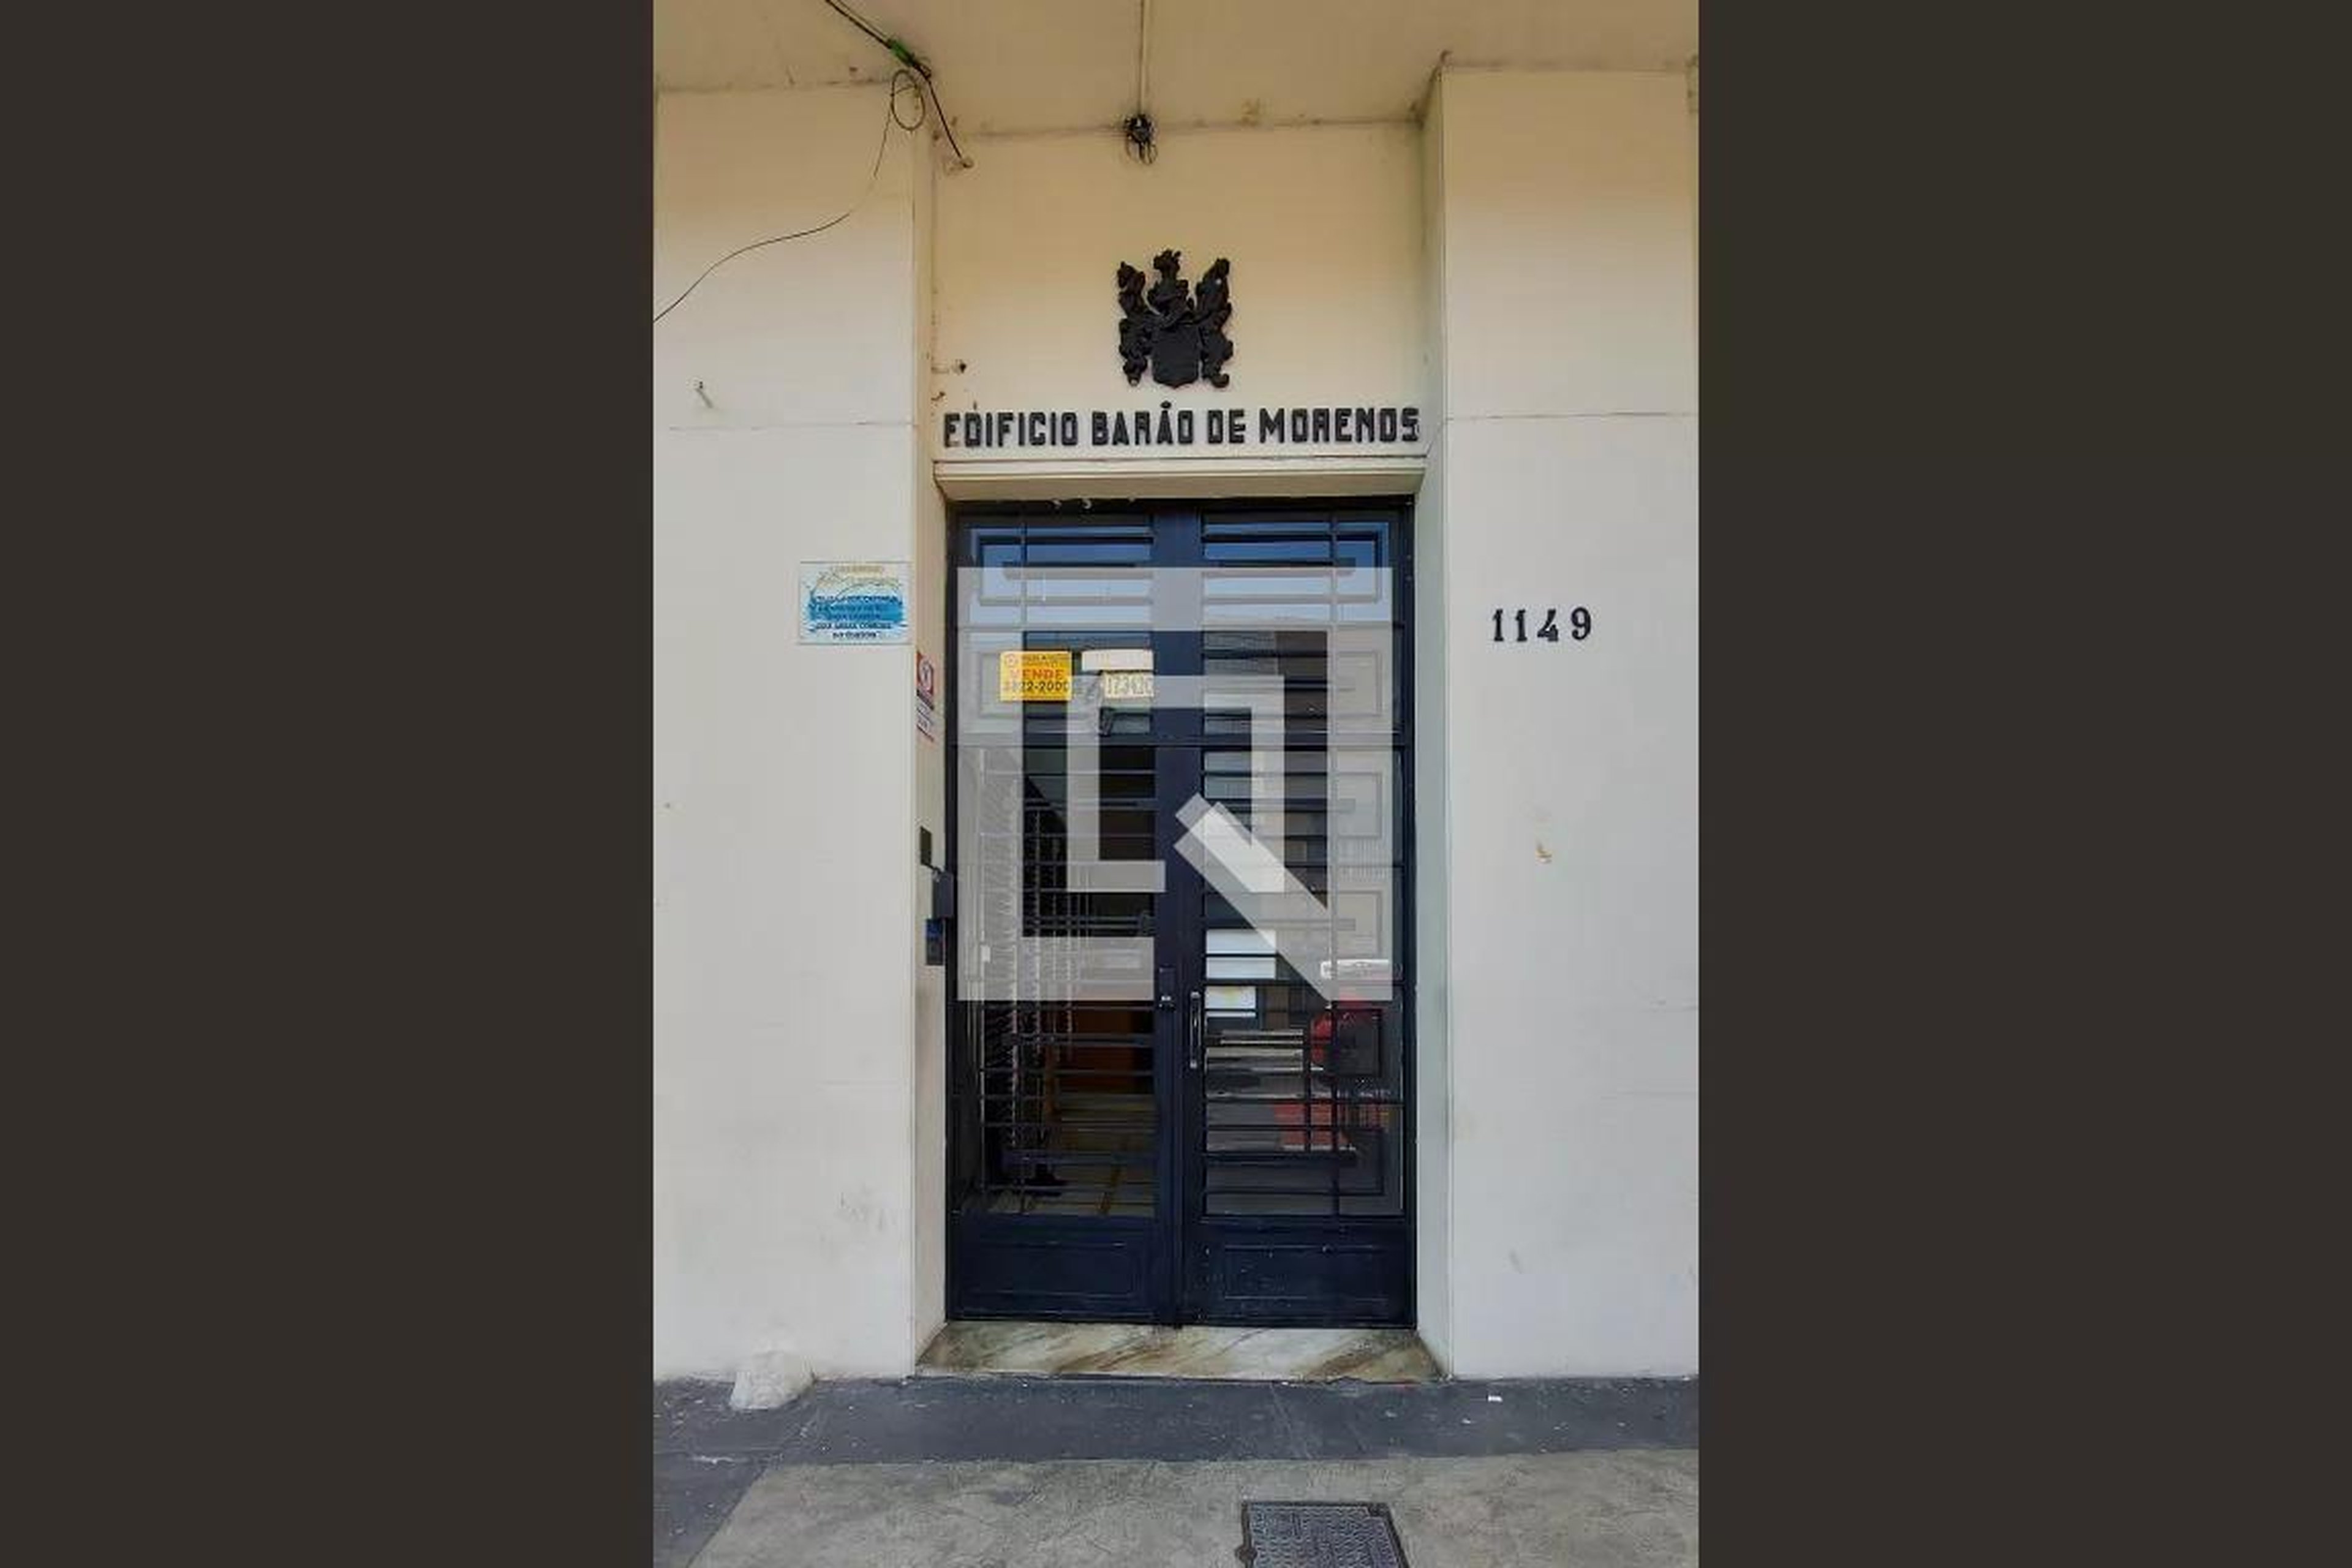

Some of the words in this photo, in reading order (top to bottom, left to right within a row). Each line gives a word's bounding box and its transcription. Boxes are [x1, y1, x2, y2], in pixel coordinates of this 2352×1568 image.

[944, 412, 1078, 447] EDIFICIO
[1091, 401, 1194, 446] BARÃO
[1207, 409, 1246, 444] DE
[1259, 407, 1420, 443] MORENOS
[1492, 606, 1592, 642] 1149
[1009, 668, 1065, 680] VENDE
